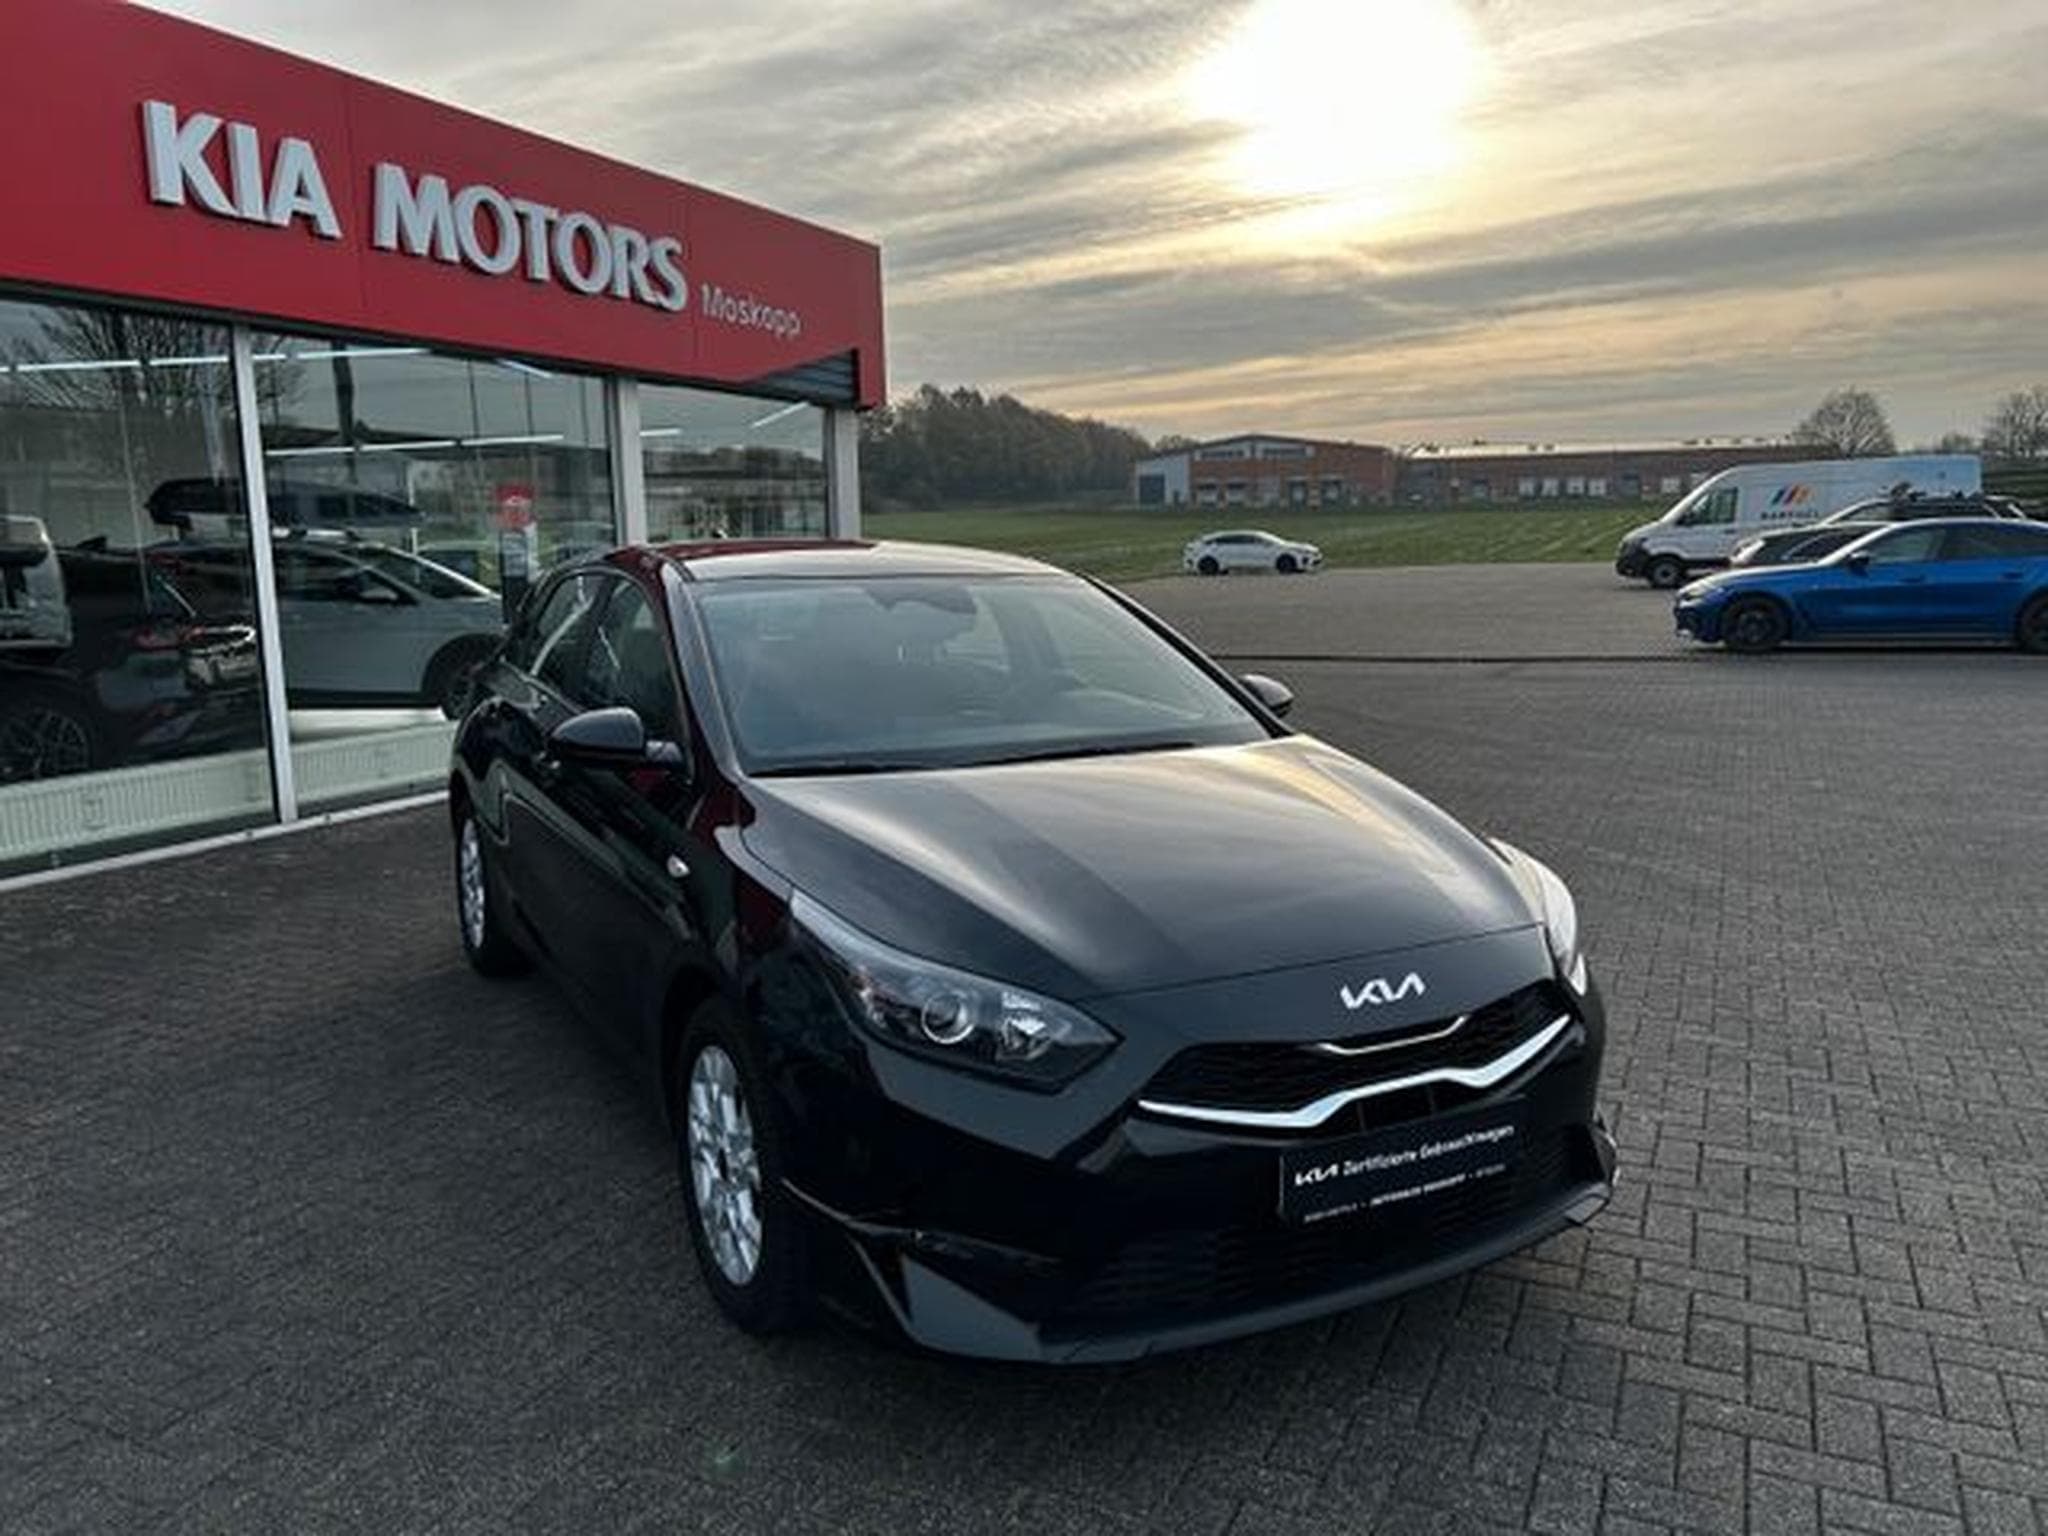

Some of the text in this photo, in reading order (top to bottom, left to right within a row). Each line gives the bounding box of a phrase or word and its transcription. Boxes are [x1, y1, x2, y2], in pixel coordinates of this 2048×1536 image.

[142, 99, 688, 312] KIA MOTORS
[701, 282, 801, 340] Moskopp
[1340, 972, 1426, 1009] KIA
